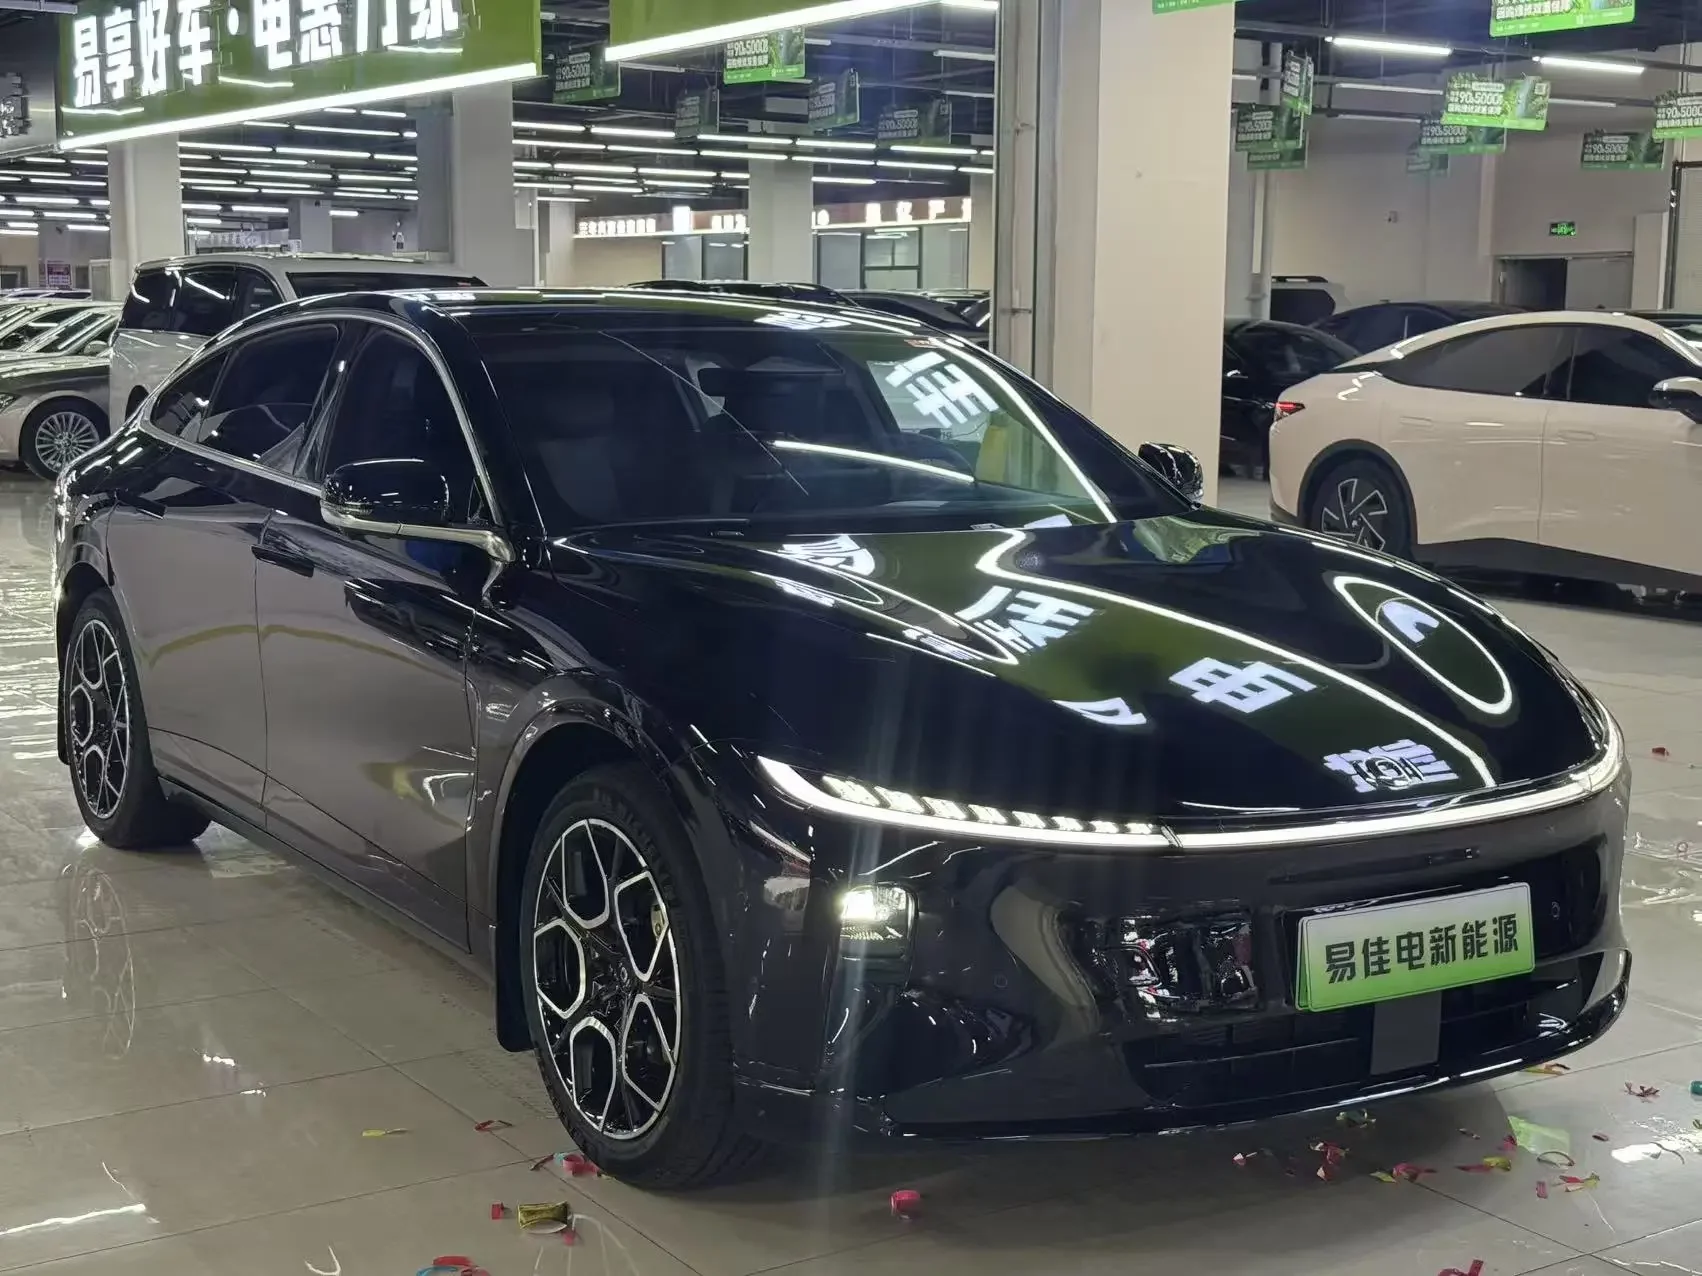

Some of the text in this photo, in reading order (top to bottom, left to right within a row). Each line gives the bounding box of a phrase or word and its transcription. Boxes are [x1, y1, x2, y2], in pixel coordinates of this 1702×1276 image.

[1325, 913, 1519, 984] 易佳电新能源
